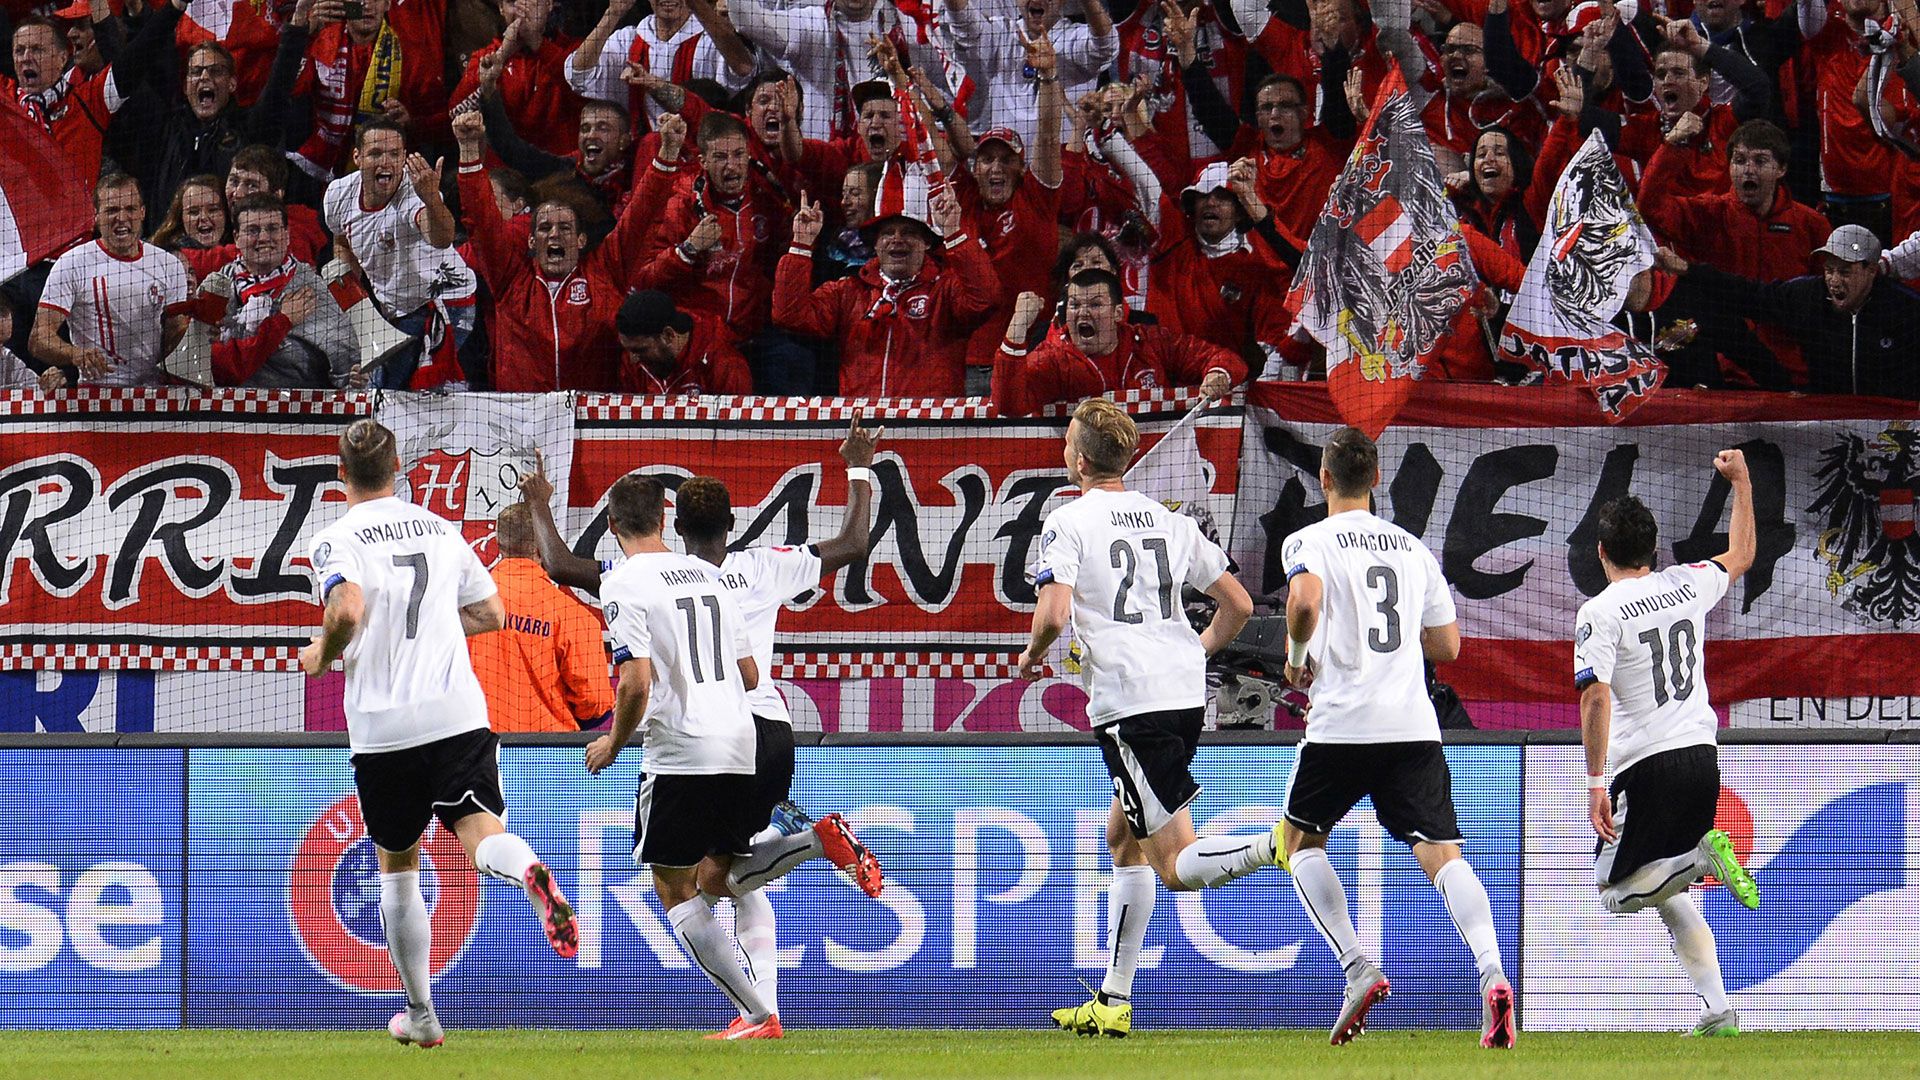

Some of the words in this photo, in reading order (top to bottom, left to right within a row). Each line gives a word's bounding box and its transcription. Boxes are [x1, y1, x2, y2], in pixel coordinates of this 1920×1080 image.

[1110, 511, 1155, 529] JANKO
[1336, 532, 1412, 552] DRAGOVIC
[392, 552, 429, 639] 7
[660, 568, 710, 588] HARNIK
[1109, 538, 1173, 625] 21
[1366, 565, 1402, 653] 3
[1619, 583, 1697, 621] JUNUZOVIC
[675, 594, 725, 684] 11
[1638, 618, 1696, 708] 10
[1770, 696, 1826, 721] EN
[577, 806, 1384, 974] RSPECT
